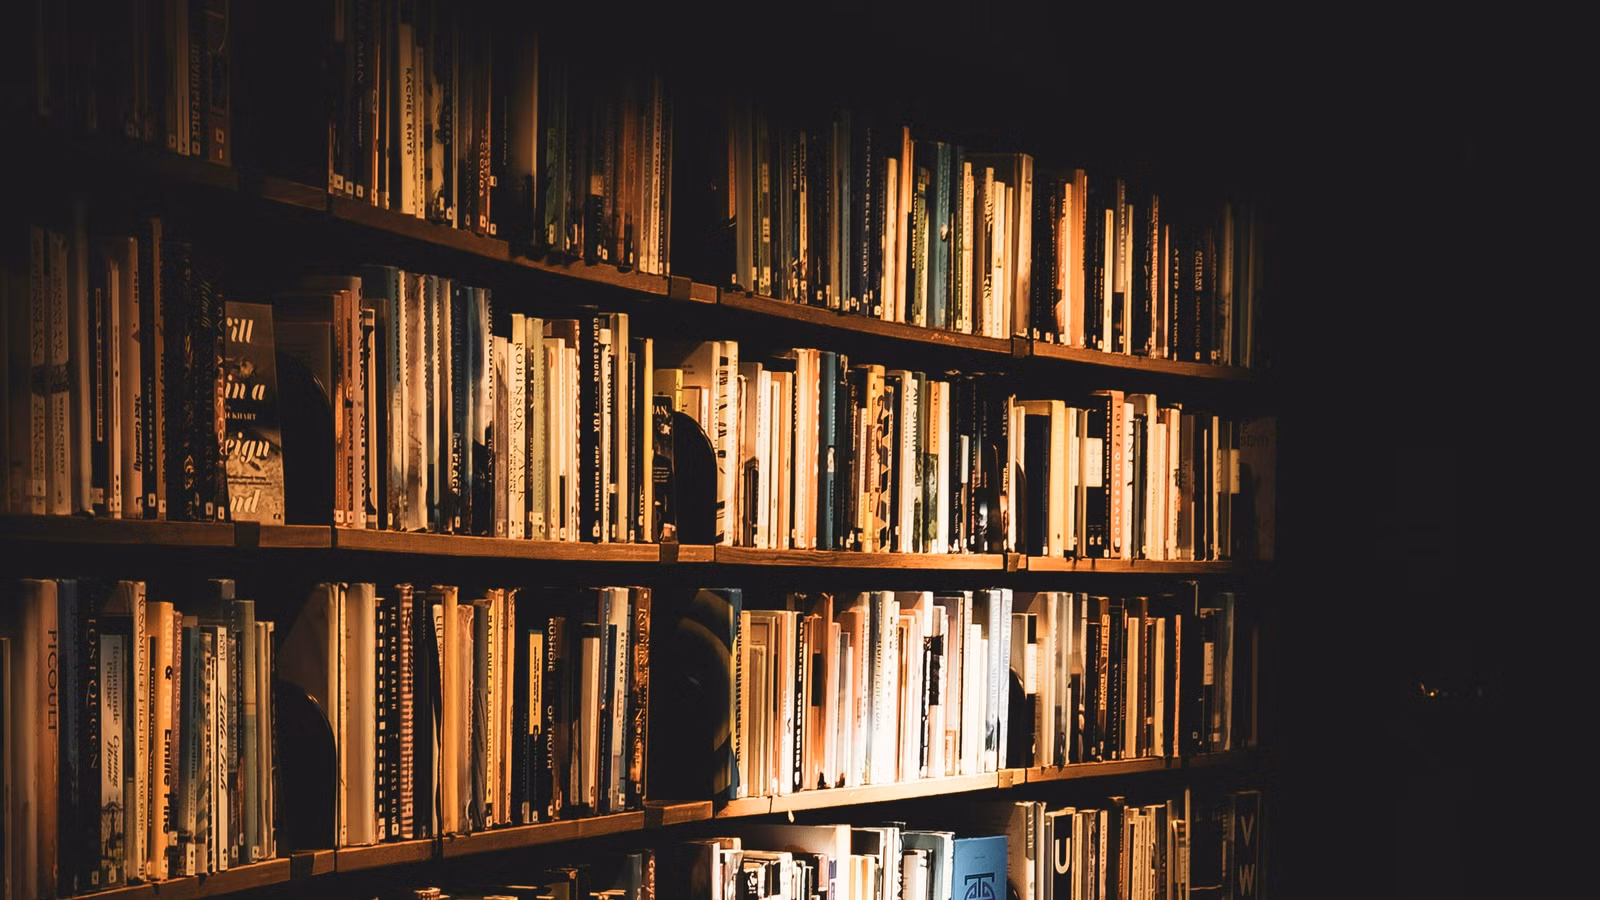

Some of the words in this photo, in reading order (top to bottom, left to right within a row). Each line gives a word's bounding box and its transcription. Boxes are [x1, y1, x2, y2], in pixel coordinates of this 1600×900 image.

[654, 136, 660, 149] TO
[217, 355, 226, 403] AFTER
[252, 383, 266, 400] a
[514, 342, 524, 432] ROBINSON
[225, 432, 270, 463] eign
[230, 489, 261, 514] nd
[1113, 450, 1121, 537] QUICKSAND
[390, 605, 398, 629] THE
[637, 606, 649, 668] RAIDERS
[86, 618, 98, 677] LOST
[138, 592, 146, 693] ROSAMUNDE
[390, 635, 398, 663] NEW
[47, 629, 58, 734] PICOULT
[106, 660, 114, 710] Pilcher
[112, 644, 121, 725] Rosamunde
[164, 665, 173, 681] &
[390, 669, 398, 711] EARTH
[86, 678, 98, 770] QUEEN
[218, 686, 228, 740] Little
[546, 704, 554, 723] OF
[106, 739, 114, 783] Home
[111, 734, 121, 788] Coming
[163, 728, 173, 787] Emilie
[218, 744, 228, 791] Fish
[546, 725, 554, 770] TRUTH
[390, 762, 398, 793] JESS
[390, 797, 398, 825] ROW
[1240, 813, 1255, 847] V
[1054, 838, 1070, 874] U
[1240, 863, 1256, 896] W
